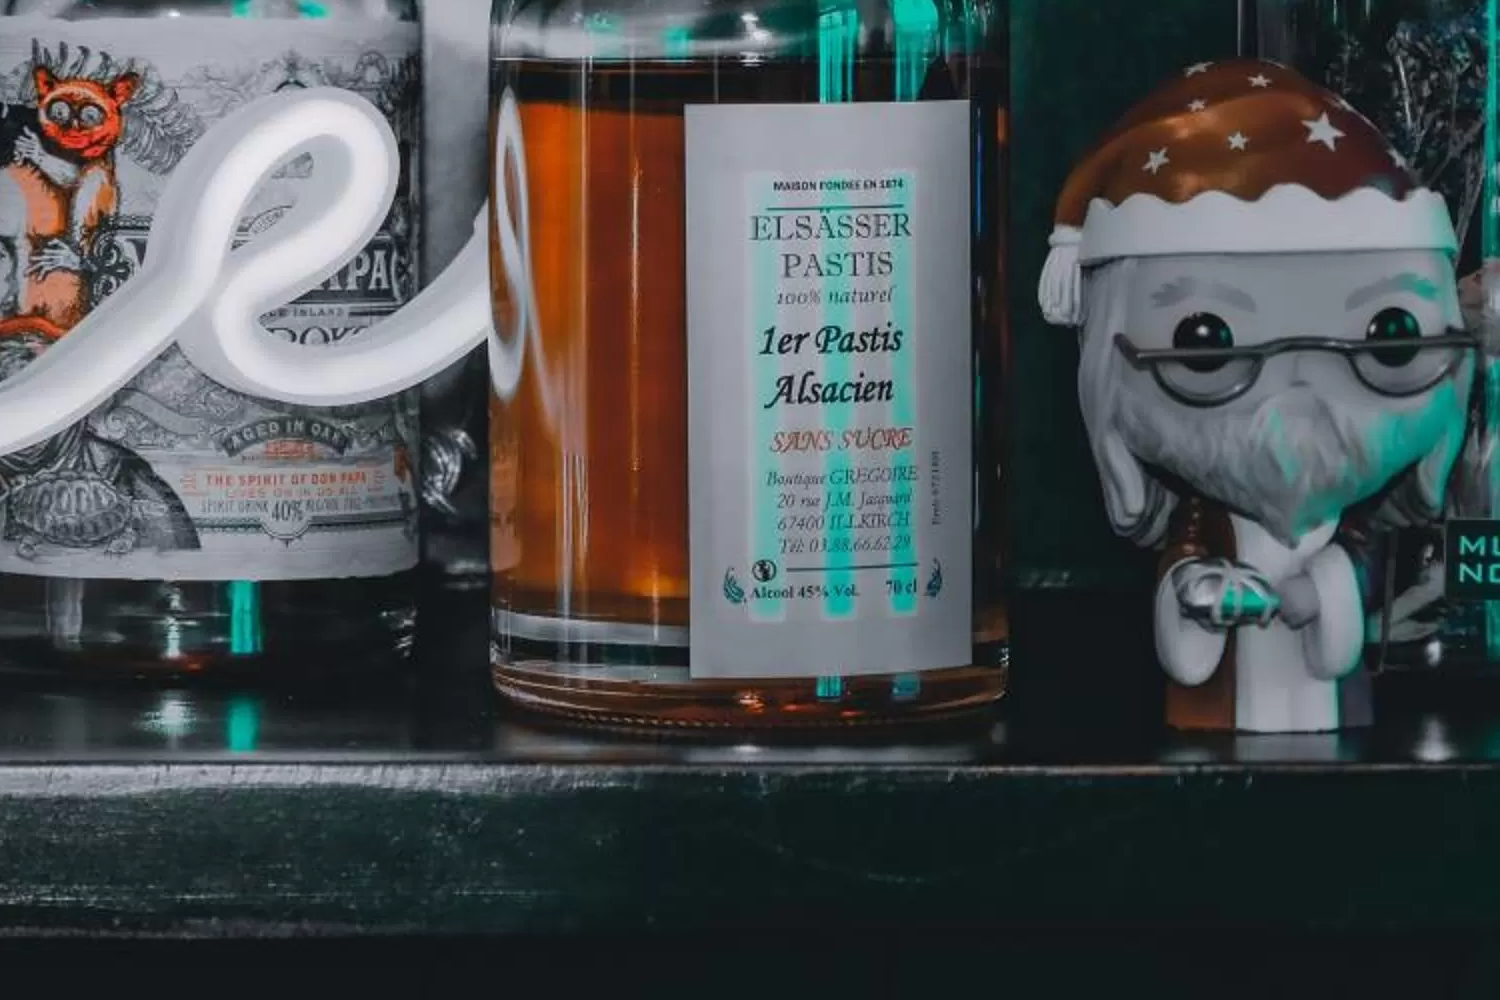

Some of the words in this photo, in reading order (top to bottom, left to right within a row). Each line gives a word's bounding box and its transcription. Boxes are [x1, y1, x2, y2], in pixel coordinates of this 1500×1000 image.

[773, 181, 817, 191] MAISON
[863, 179, 878, 188] EN
[749, 208, 913, 241] ELSÄSSER
[783, 251, 894, 279] PASTIS
[777, 289, 821, 305] 100%
[828, 285, 898, 305] naturel
[759, 325, 811, 356] 1er
[815, 320, 904, 355] Pastis
[763, 370, 894, 410] Alsacien
[286, 419, 305, 434] IN
[770, 430, 834, 454] SANS
[837, 426, 914, 451] SUCRE
[206, 474, 234, 487] THE
[238, 473, 285, 487] SPIRIT
[766, 470, 825, 490] Boutique
[828, 465, 919, 486] GREGOIRE
[777, 493, 797, 509] 20
[777, 515, 825, 531] 67400
[828, 511, 910, 530] ILLKIRCH
[751, 586, 794, 600] Alcool
[797, 585, 829, 599] 45%
